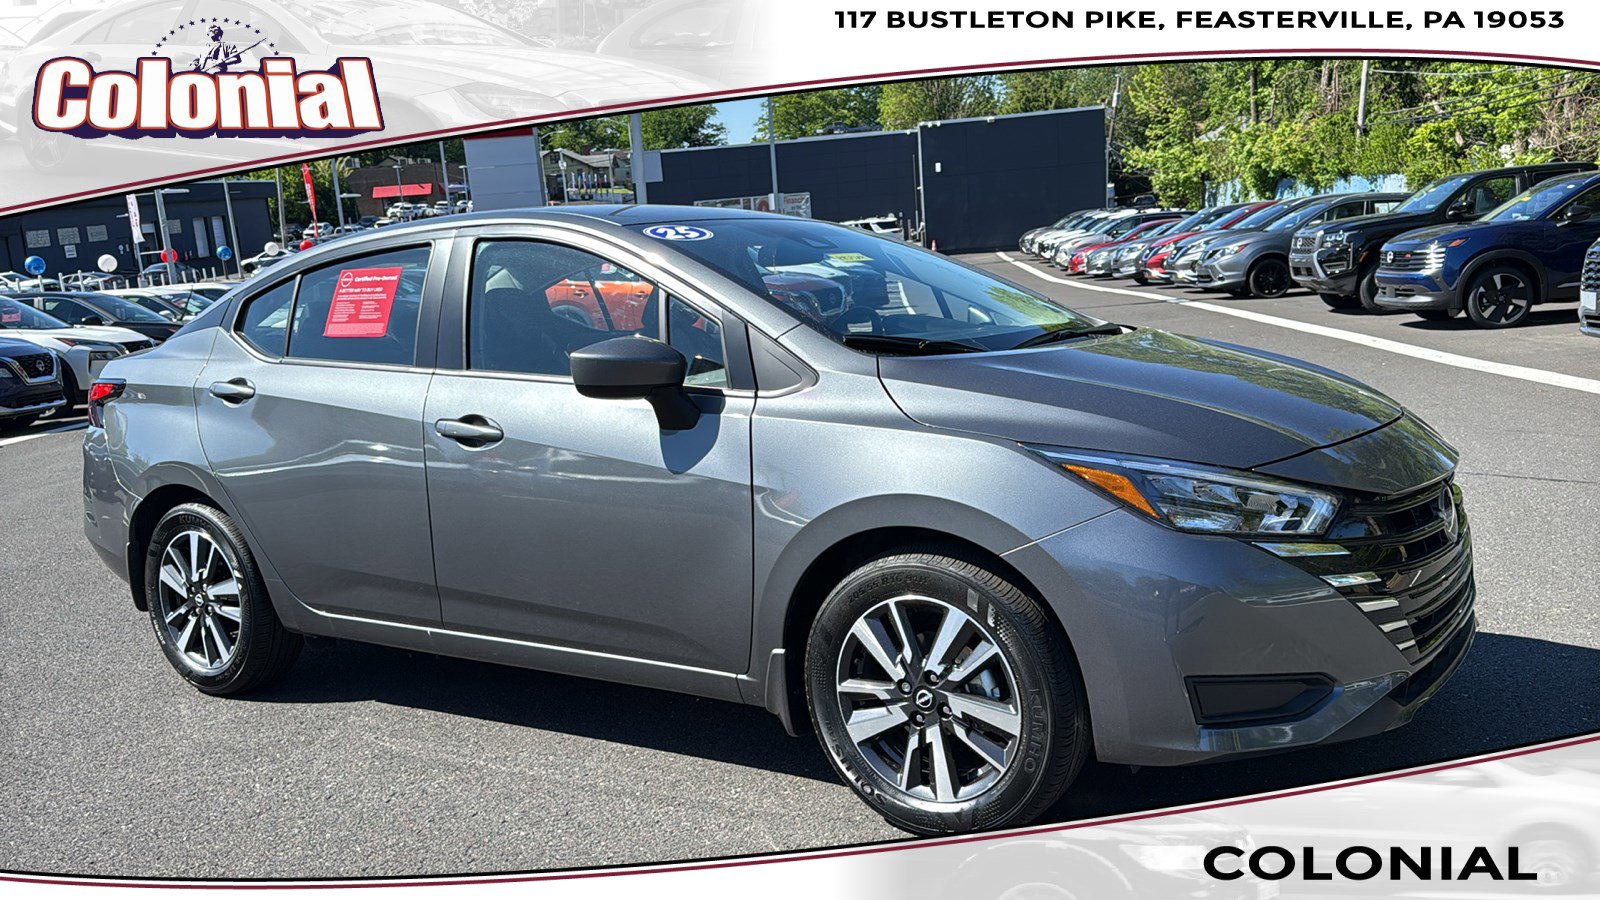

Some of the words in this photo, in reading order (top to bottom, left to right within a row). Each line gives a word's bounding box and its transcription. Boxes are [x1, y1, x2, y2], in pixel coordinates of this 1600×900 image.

[655, 226, 700, 239] 25
[1024, 688, 1047, 775] KUMHO
[831, 743, 888, 806] SOLUS
